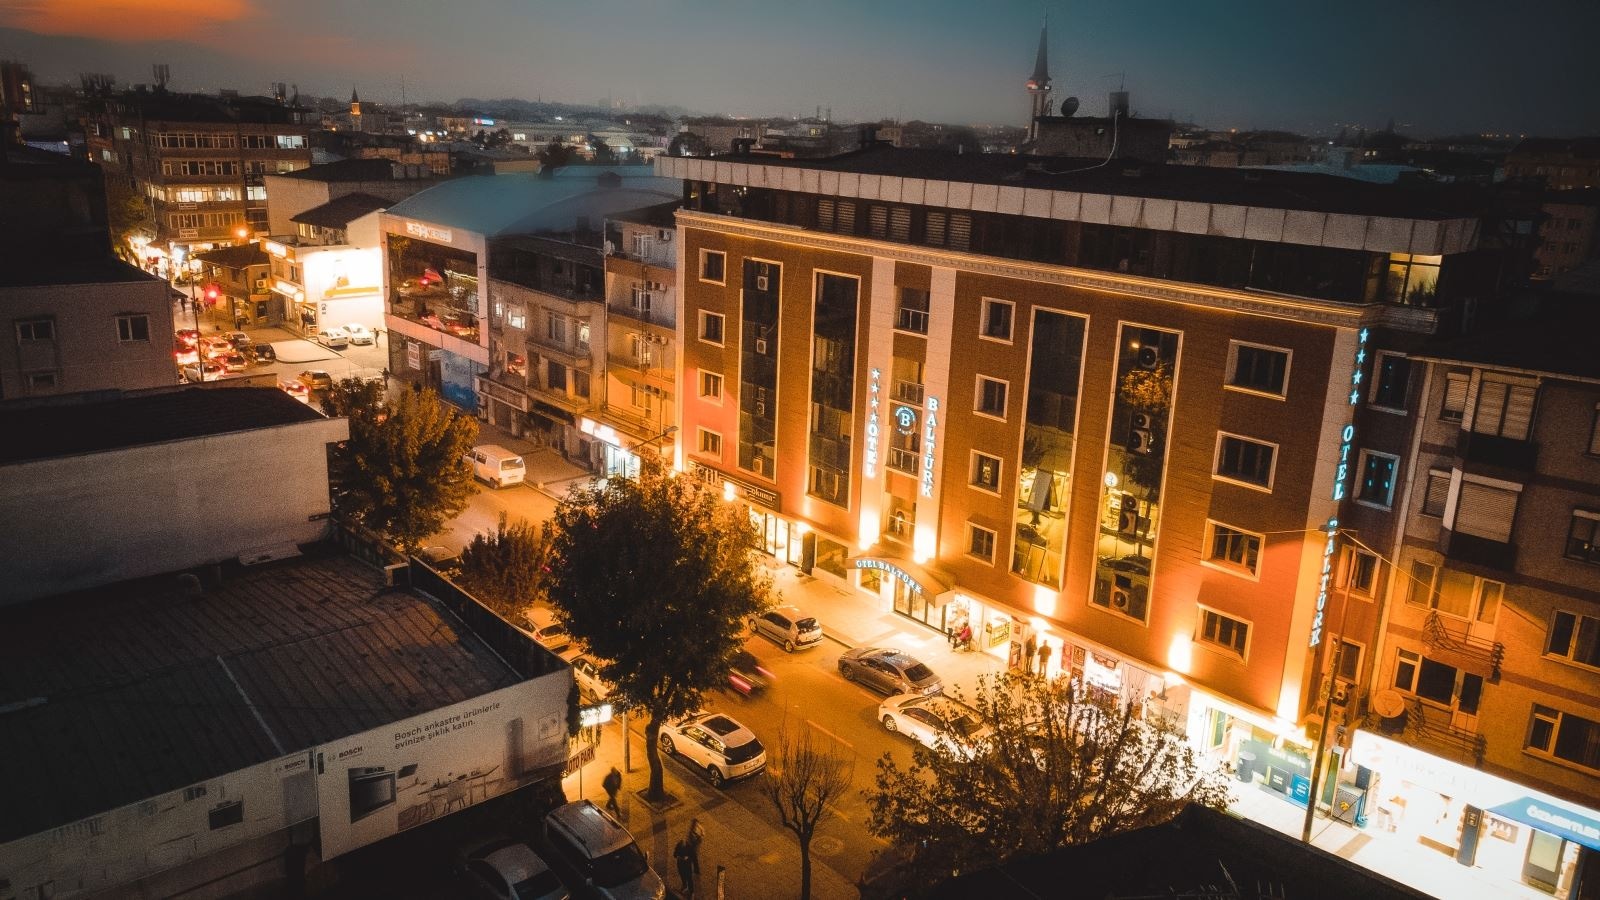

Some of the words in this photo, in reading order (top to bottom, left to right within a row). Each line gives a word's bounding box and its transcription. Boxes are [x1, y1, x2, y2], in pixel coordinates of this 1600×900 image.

[866, 422, 879, 478] OTEL
[1332, 425, 1354, 501] OTEL
[856, 560, 878, 569] OTEL
[394, 726, 422, 741] Bosch
[424, 715, 461, 732] ankastre
[463, 702, 500, 719] ürünlerle
[338, 746, 363, 758] BOSCH
[394, 734, 426, 750] evinize
[284, 759, 306, 770] BOSCH
[568, 755, 580, 774] OTO
[580, 746, 595, 767] PARK
